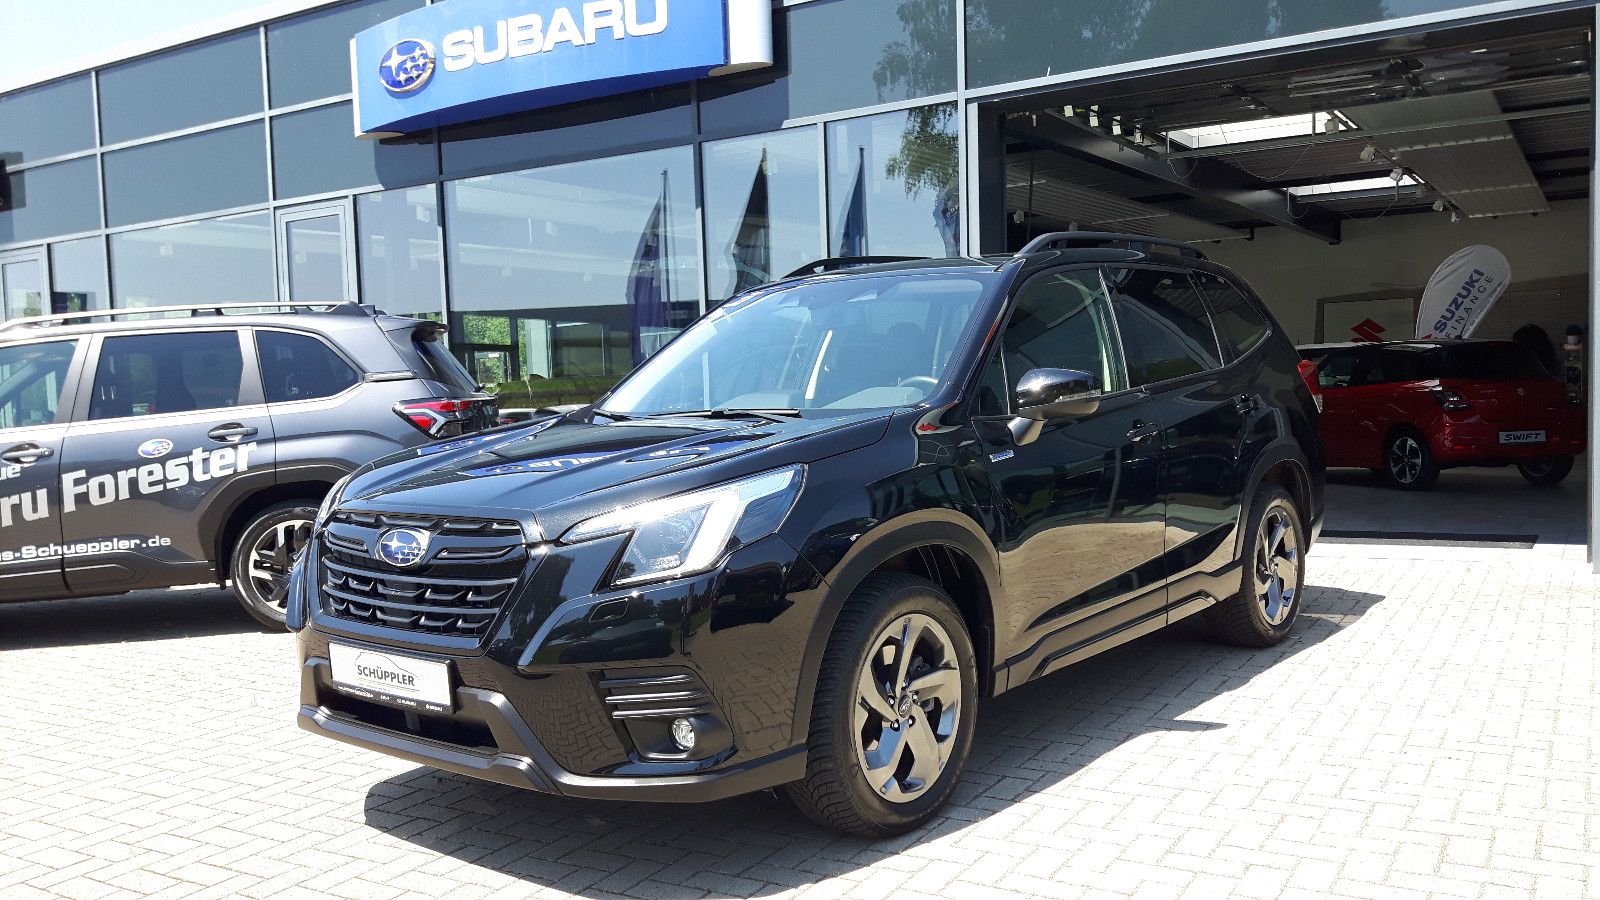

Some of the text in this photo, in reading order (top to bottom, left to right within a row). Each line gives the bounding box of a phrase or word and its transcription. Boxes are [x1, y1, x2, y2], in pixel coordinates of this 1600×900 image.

[442, 0, 668, 73] SUBARU
[1433, 268, 1485, 333] SUZUKI
[1445, 275, 1494, 338] FINANCE
[1503, 432, 1542, 442] SWIFT
[61, 441, 257, 513] Forester
[0, 535, 171, 562] s-Schueppler.de
[357, 664, 416, 687] SCHÜPPLER
